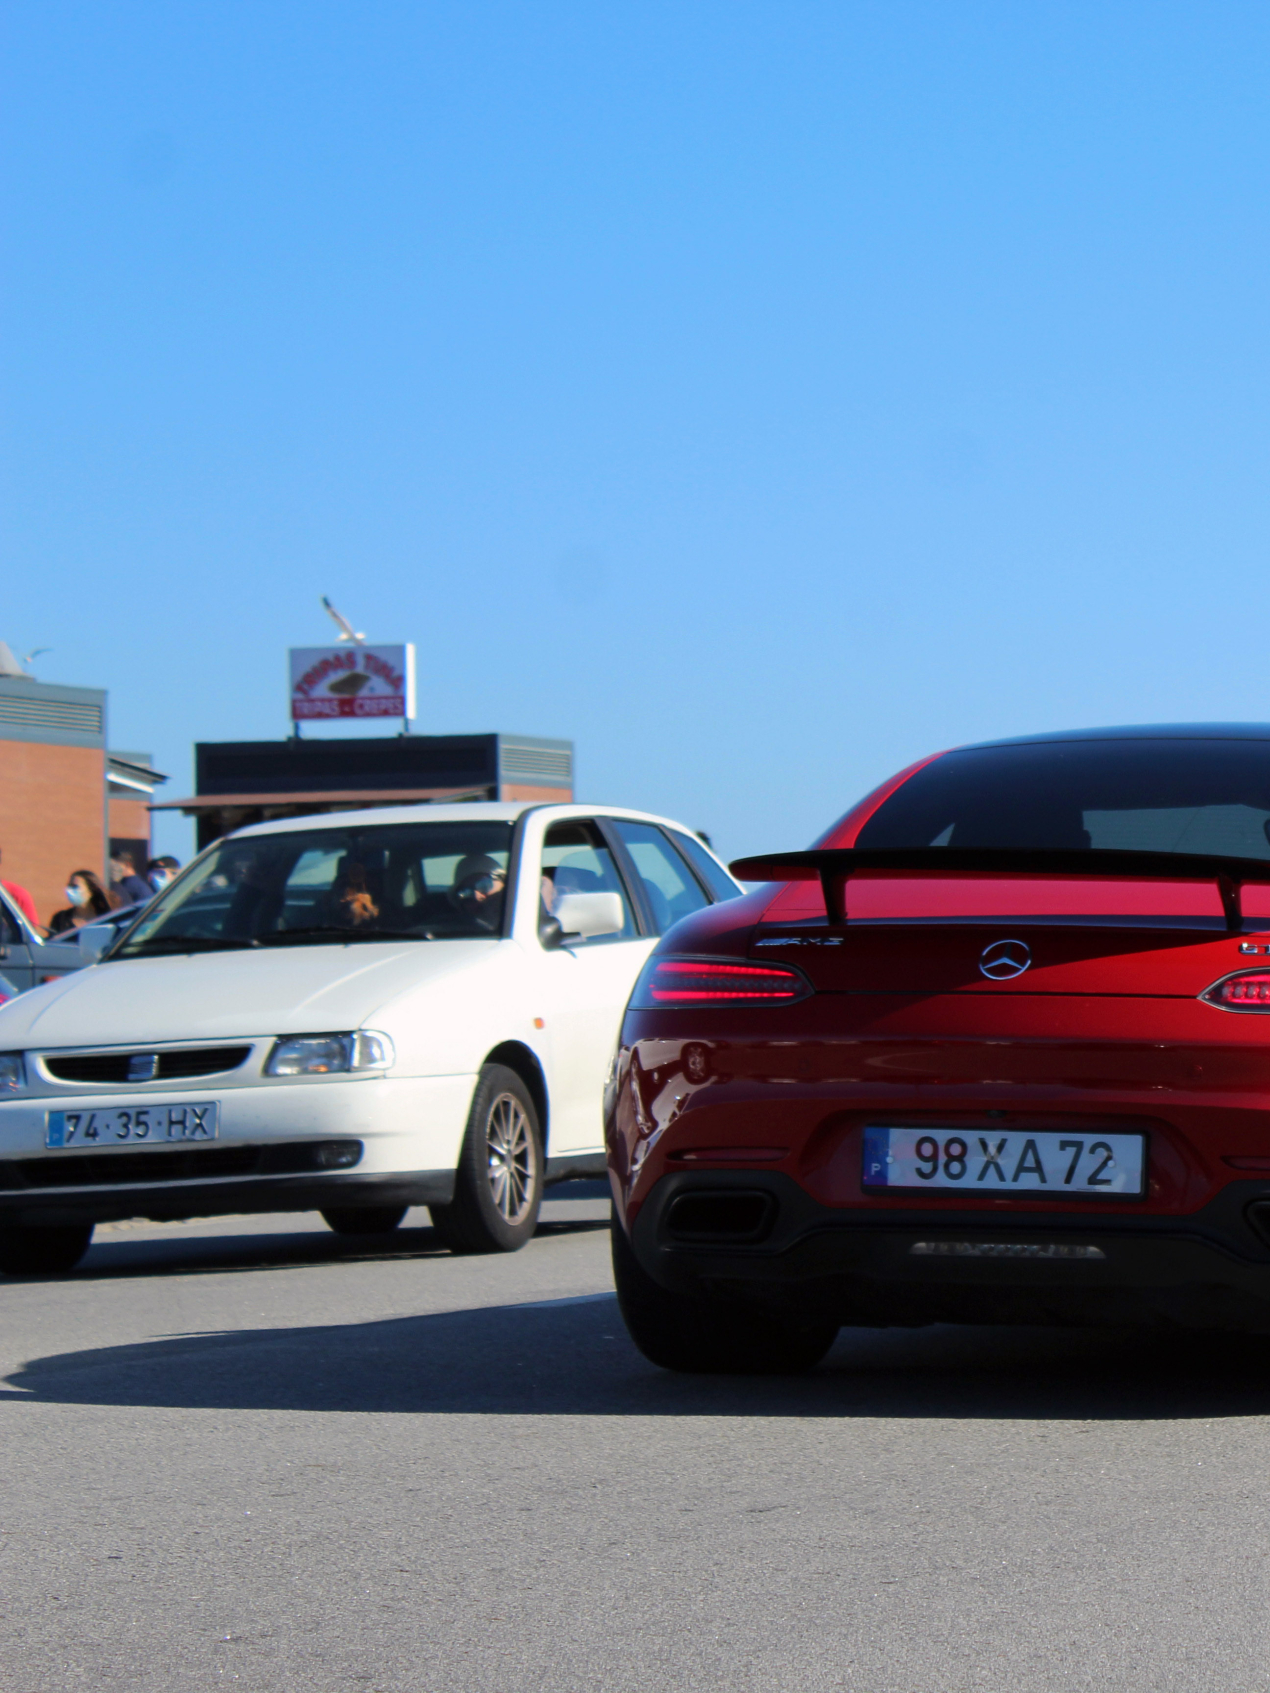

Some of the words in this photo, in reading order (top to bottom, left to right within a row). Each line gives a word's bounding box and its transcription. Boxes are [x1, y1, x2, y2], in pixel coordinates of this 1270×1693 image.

[294, 651, 357, 696] TRIPAS
[294, 701, 340, 718] TRIPAS
[870, 1163, 881, 1175] P
